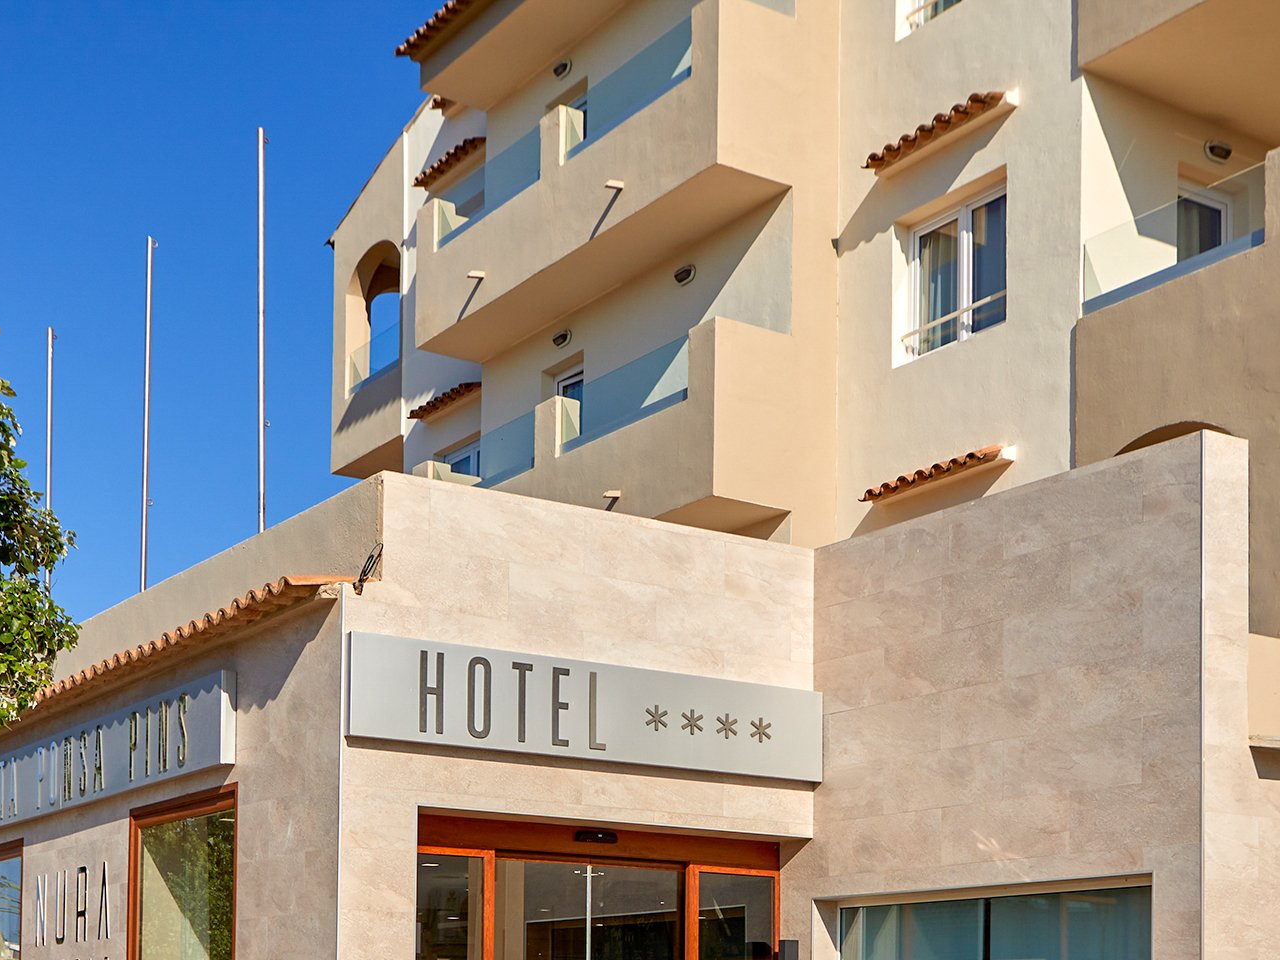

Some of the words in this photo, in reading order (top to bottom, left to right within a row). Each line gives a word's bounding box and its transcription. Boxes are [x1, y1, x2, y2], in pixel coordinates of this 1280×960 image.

[418, 650, 607, 751] HOTEL
[36, 725, 105, 811] PONSA
[128, 692, 188, 783] PINS
[36, 861, 111, 946] NURA
